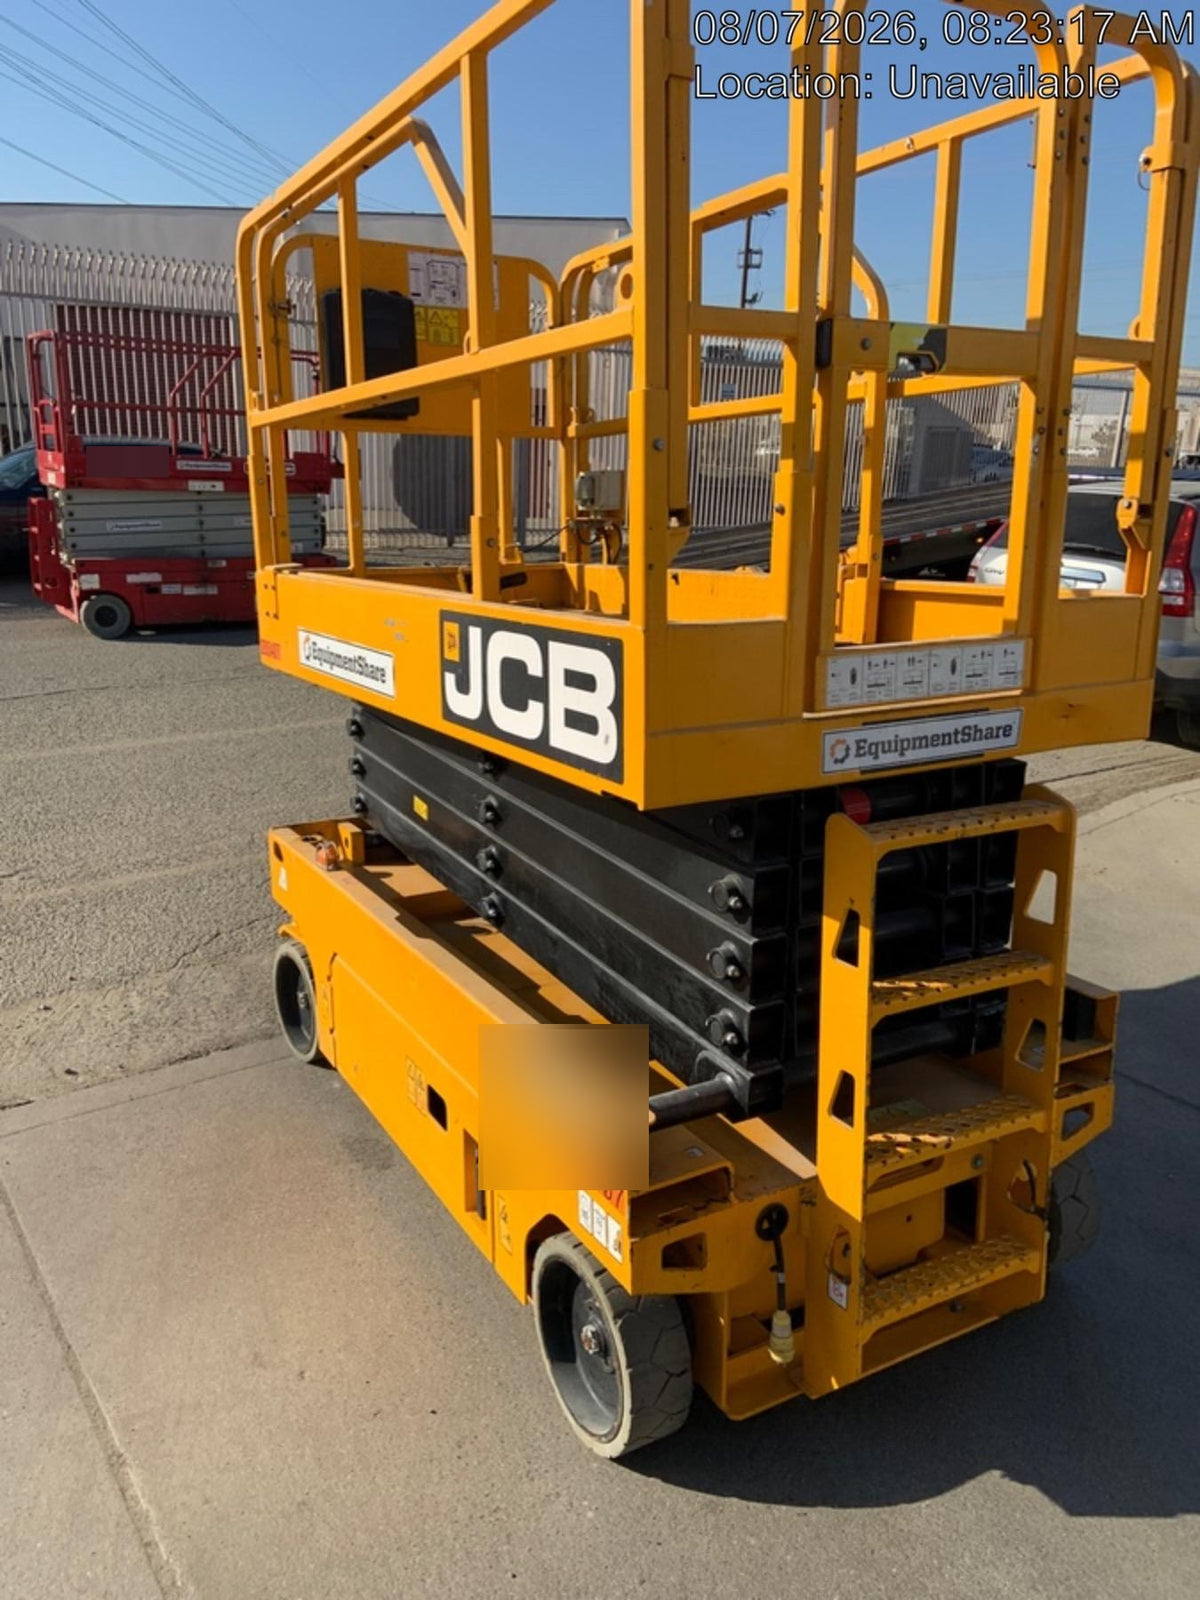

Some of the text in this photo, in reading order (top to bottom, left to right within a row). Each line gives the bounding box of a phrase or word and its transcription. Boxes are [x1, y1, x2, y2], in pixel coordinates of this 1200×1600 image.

[312, 641, 386, 684] EquipmentShare
[443, 625, 617, 764] JCB
[853, 723, 1012, 759] EquipmentShare
